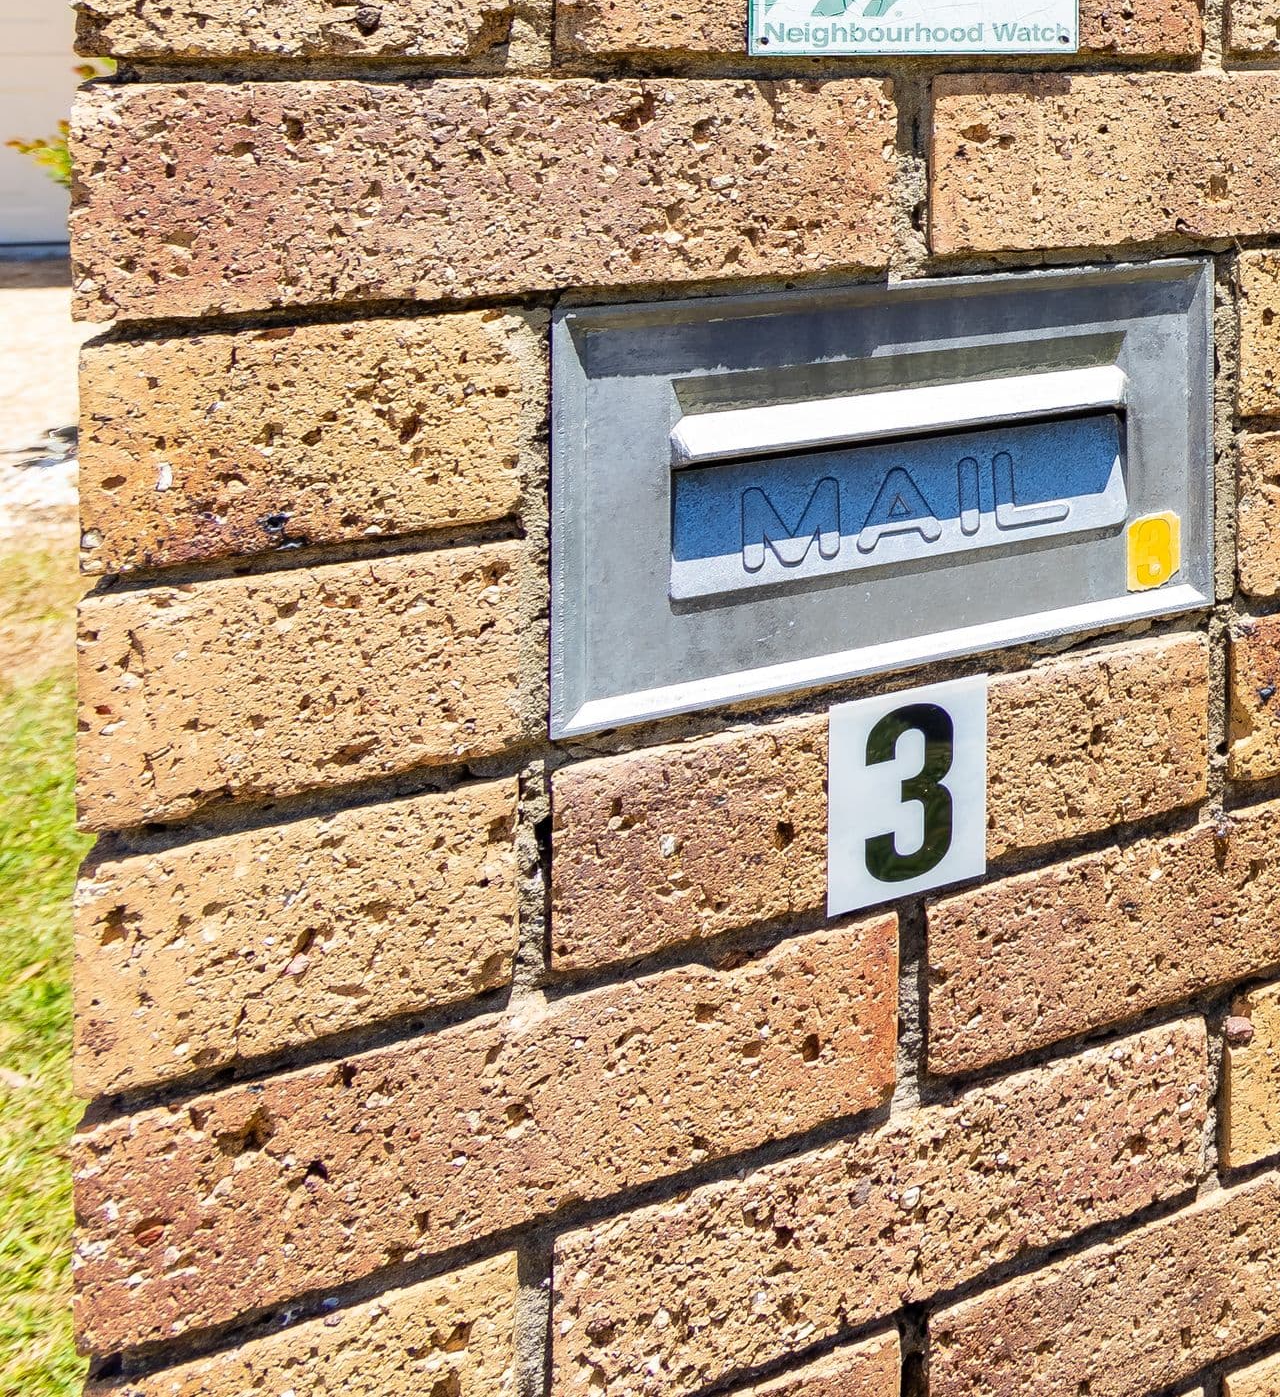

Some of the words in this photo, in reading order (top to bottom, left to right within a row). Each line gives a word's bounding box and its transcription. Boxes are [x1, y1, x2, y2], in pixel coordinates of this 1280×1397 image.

[764, 23, 983, 47] Neighbourhood
[741, 451, 1070, 571] MAIL
[1137, 518, 1172, 587] 3
[865, 703, 954, 883] 3
